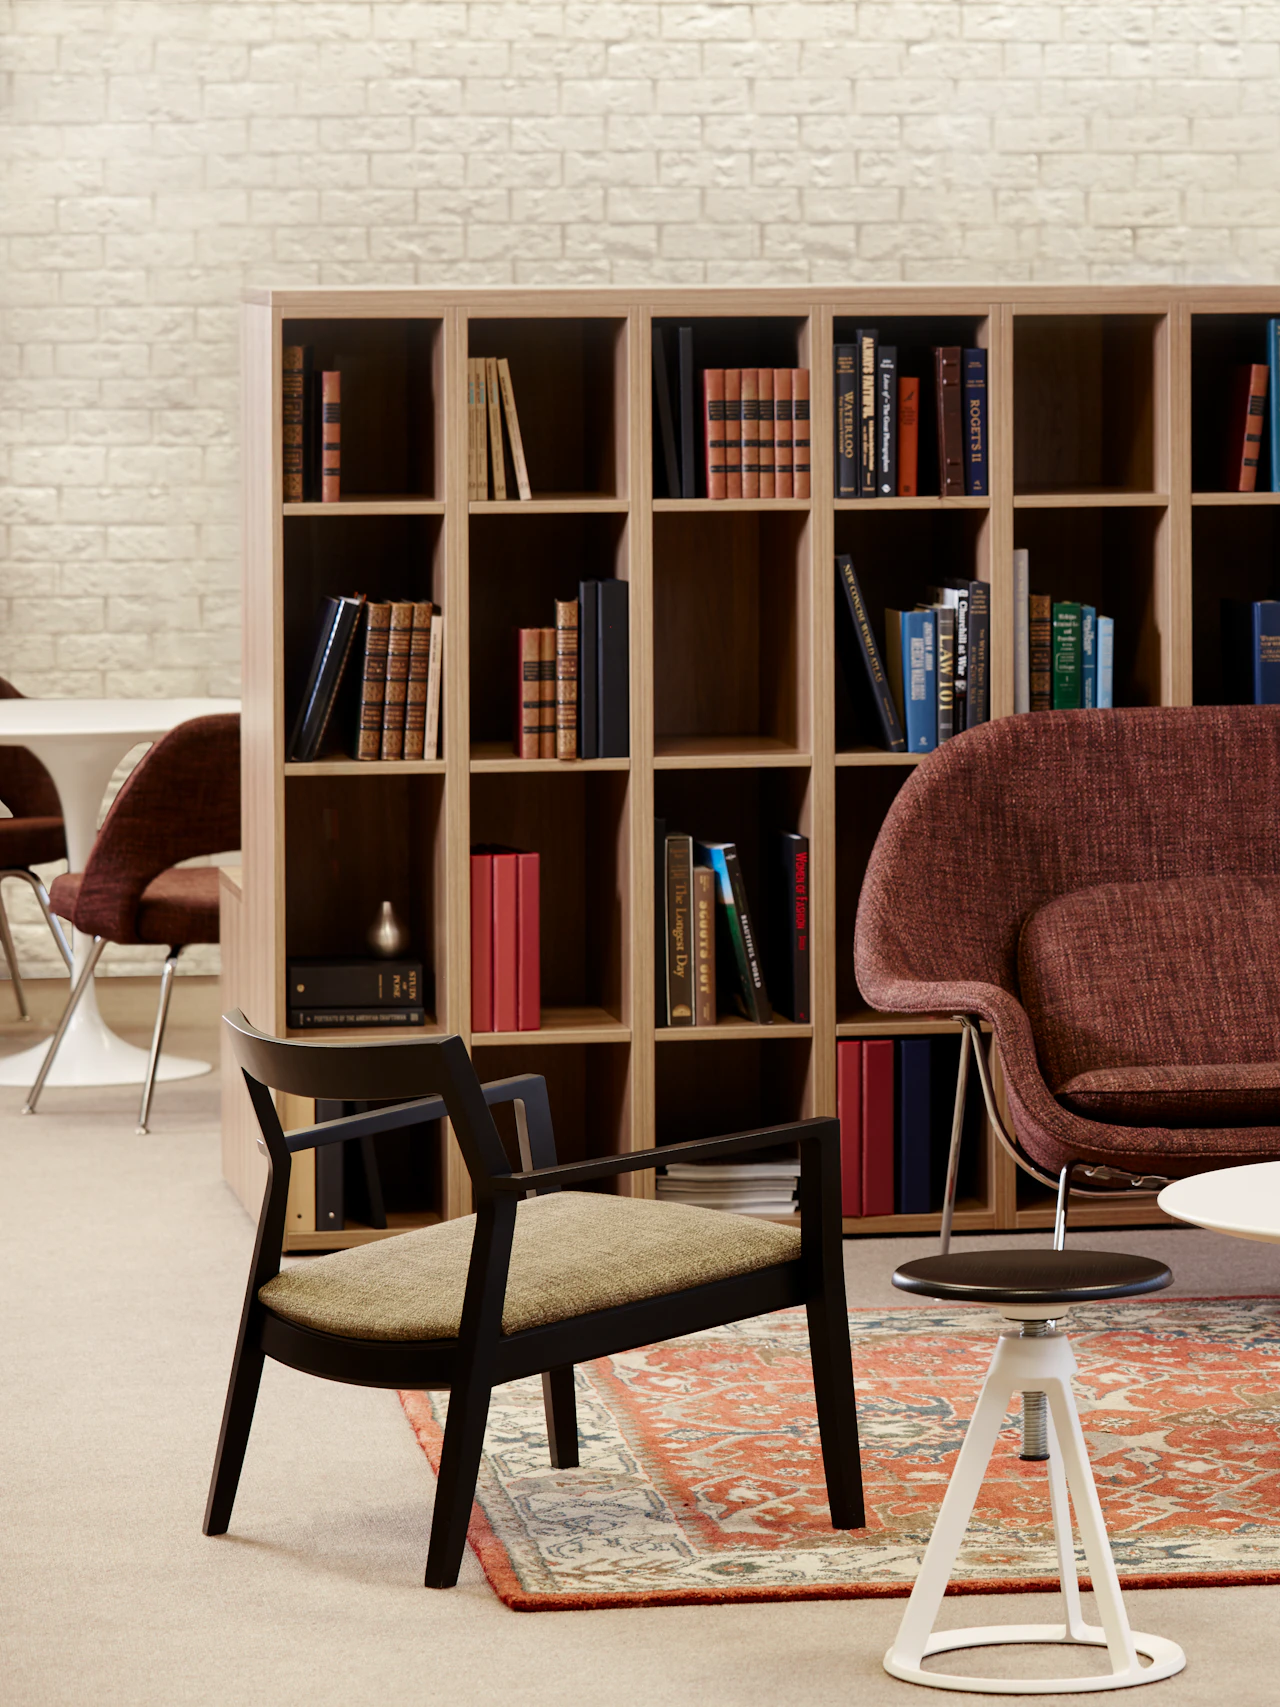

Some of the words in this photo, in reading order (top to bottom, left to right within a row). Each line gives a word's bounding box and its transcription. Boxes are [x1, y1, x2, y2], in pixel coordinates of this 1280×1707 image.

[862, 336, 874, 374] ALWAYS
[862, 375, 875, 419] FAITHFUL
[844, 391, 854, 459] WATERLOO
[843, 564, 856, 584] NEW
[850, 585, 866, 622] CONCISE
[861, 623, 876, 656] WORLD
[871, 657, 884, 683] ATLAS
[958, 600, 968, 644] Churchill
[940, 634, 954, 676] LAW
[957, 656, 967, 677] War
[958, 644, 966, 655] at
[940, 682, 954, 710] 101
[795, 852, 808, 883] WOMEN
[676, 881, 687, 904] The
[795, 884, 805, 894] OF
[672, 907, 687, 951] Longest
[795, 896, 808, 929] FASHION
[673, 954, 688, 978] Day
[740, 914, 756, 959] BEAUTIFUL
[751, 960, 762, 988] WORLD
